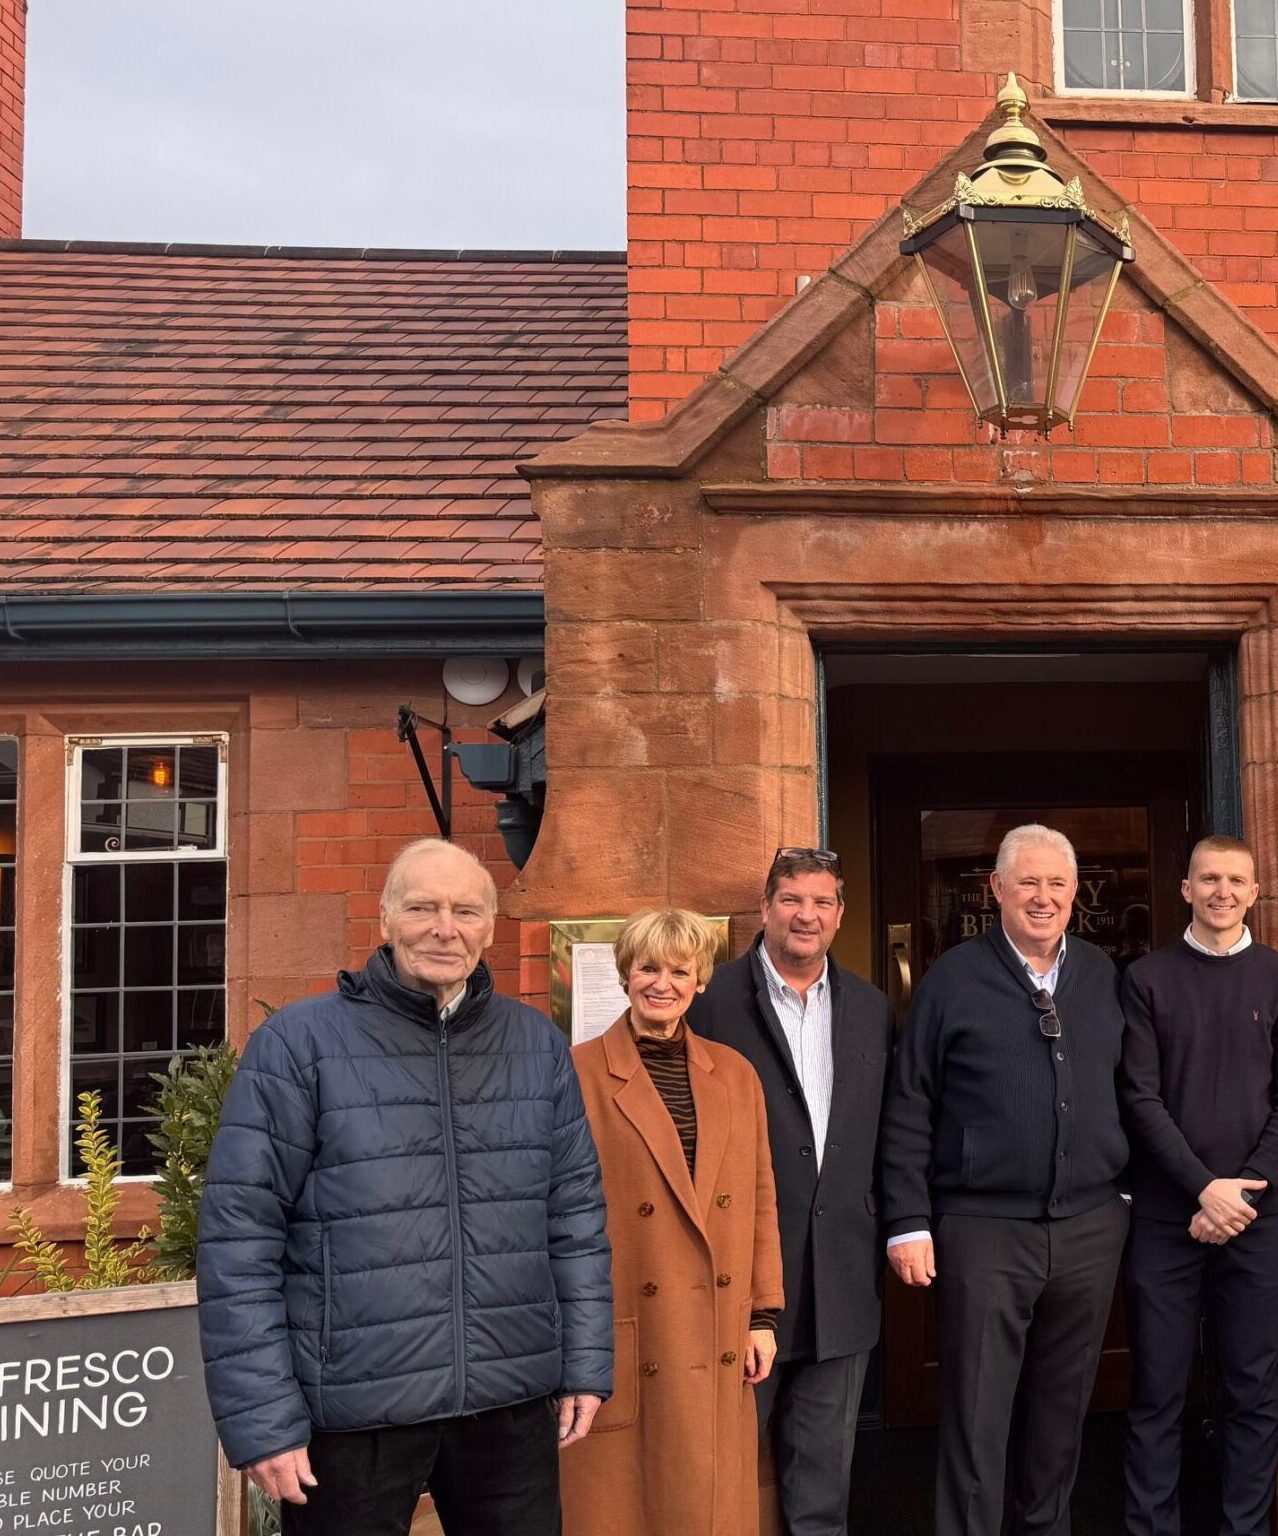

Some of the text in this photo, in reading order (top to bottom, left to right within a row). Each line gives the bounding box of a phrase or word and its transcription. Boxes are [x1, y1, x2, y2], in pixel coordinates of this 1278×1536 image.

[1096, 915, 1115, 926] 1911
[0, 1346, 175, 1397] FRESCO
[30, 1461, 91, 1482] QUOTE
[101, 1453, 151, 1473] YOUR
[42, 1480, 122, 1503] NUMBER
[14, 1508, 74, 1531] PLACE
[82, 1500, 136, 1520] YOUR
